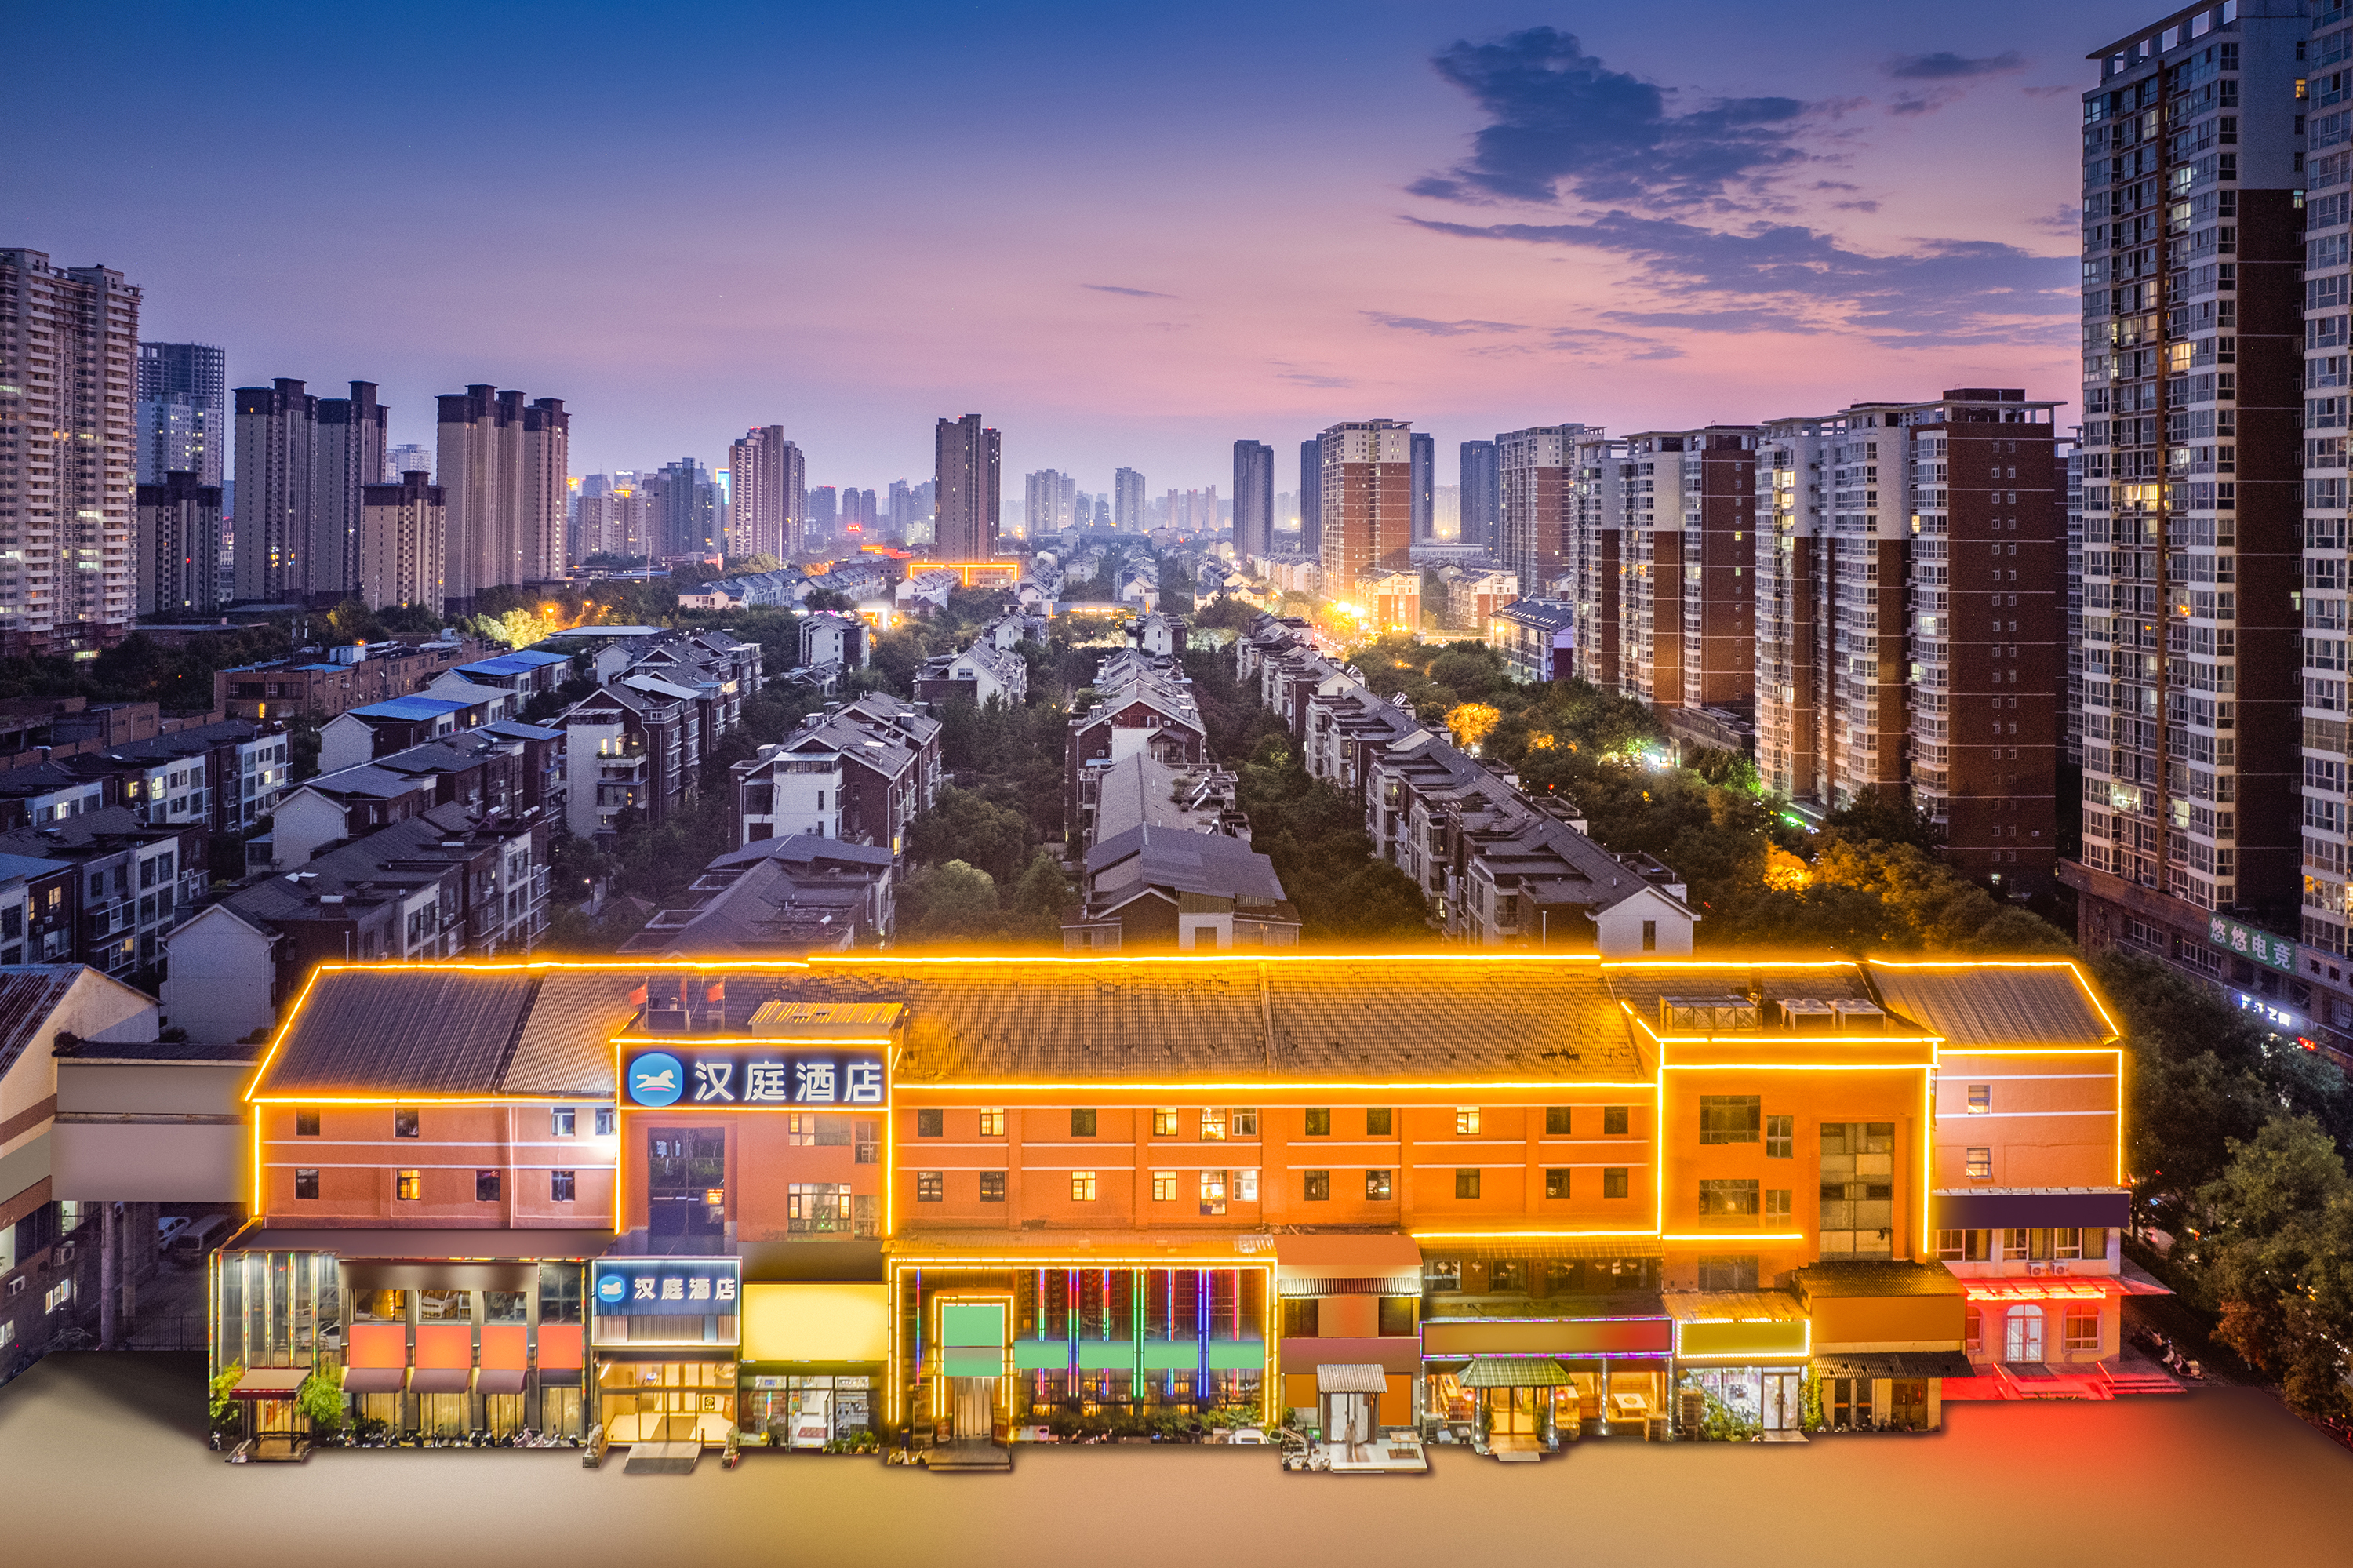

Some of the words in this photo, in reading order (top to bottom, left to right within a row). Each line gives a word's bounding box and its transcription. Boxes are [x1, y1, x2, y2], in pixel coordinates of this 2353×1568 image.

[2210, 917, 2292, 970] 悠悠电竞
[694, 1060, 882, 1102] 汉庭酒店
[634, 1278, 736, 1301] 汉庭酒店
